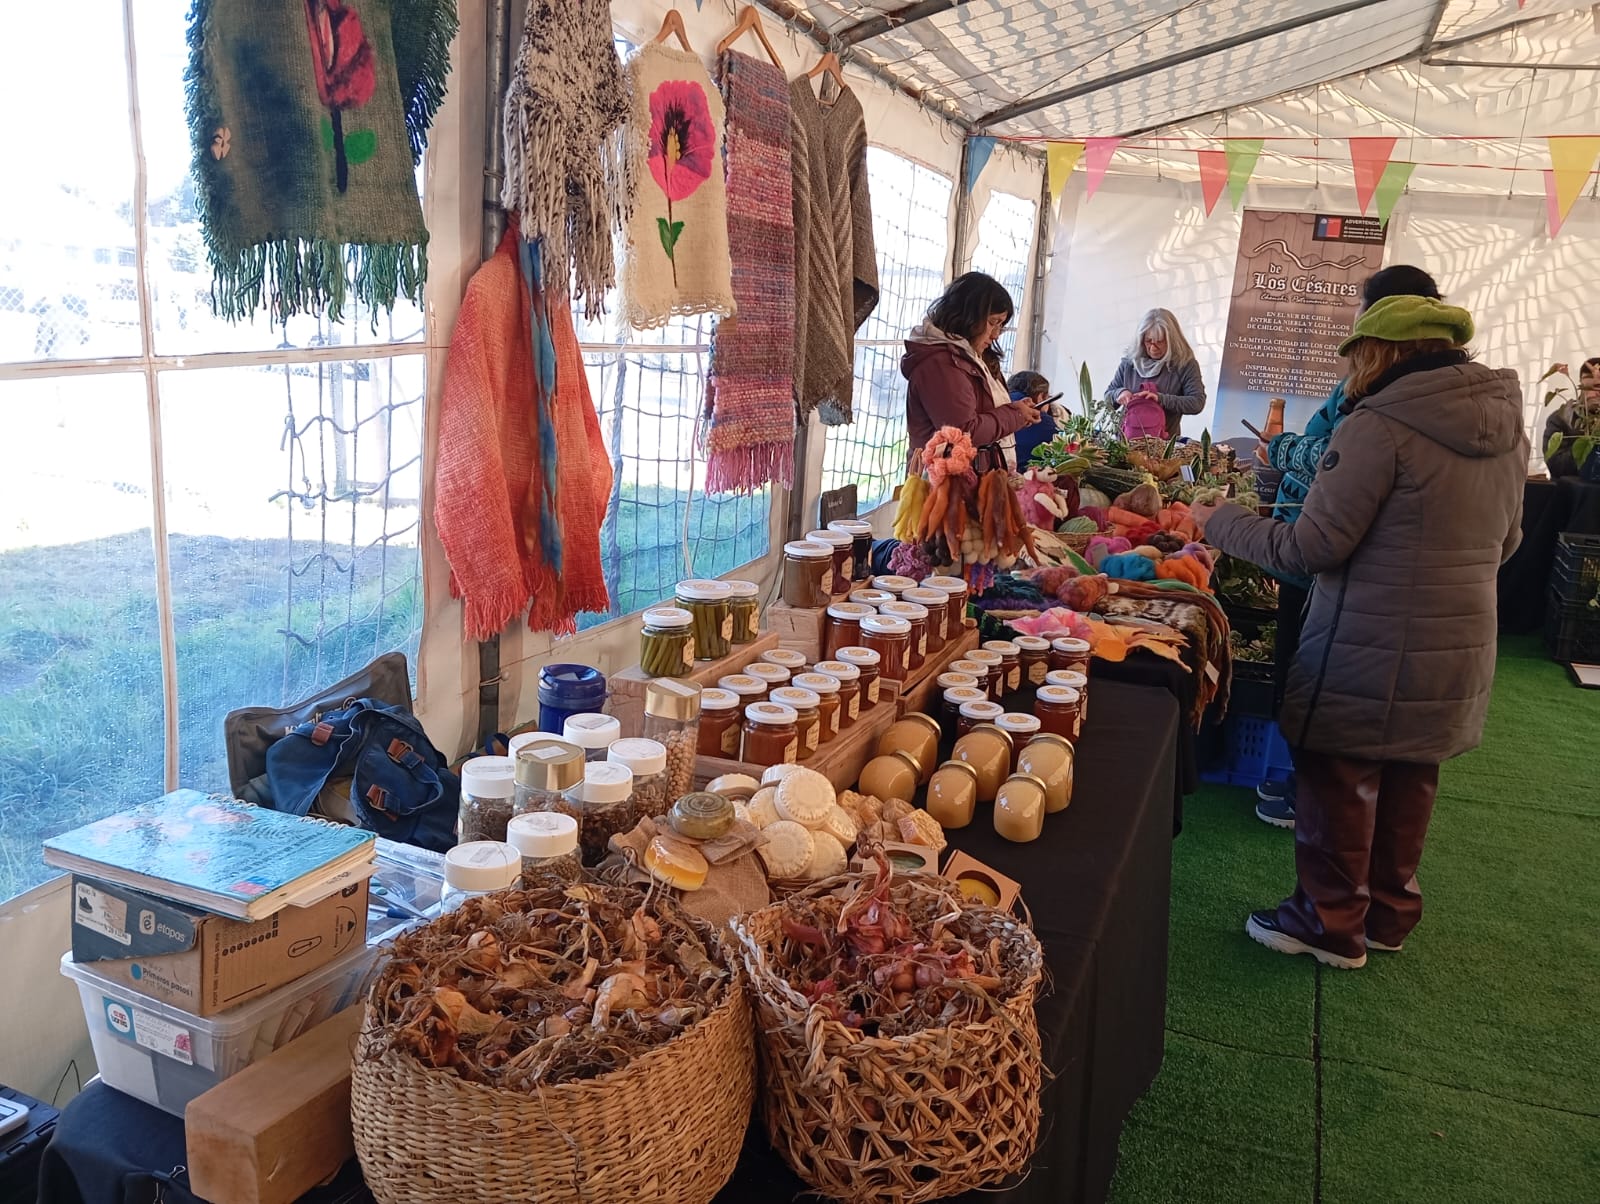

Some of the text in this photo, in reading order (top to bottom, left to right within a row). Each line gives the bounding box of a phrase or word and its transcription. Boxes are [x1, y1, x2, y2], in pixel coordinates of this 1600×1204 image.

[1270, 263, 1282, 274] de
[1253, 272, 1357, 296] Los Césares
[1283, 319, 1307, 327] NIEBLA
[1273, 339, 1299, 347] CIUDAD
[1240, 343, 1261, 351] LUGAR
[1263, 344, 1287, 352] DONDE
[1298, 347, 1323, 356] TIEMPO
[1266, 353, 1300, 361] FELICIDAD
[1245, 364, 1280, 372] INSPIRADA
[1258, 372, 1287, 380] CERVEZA
[1264, 380, 1294, 388] CAPTURA
[1305, 383, 1332, 391] ESENCIA
[157, 923, 185, 943] etapas
[143, 967, 170, 985] Primeros
